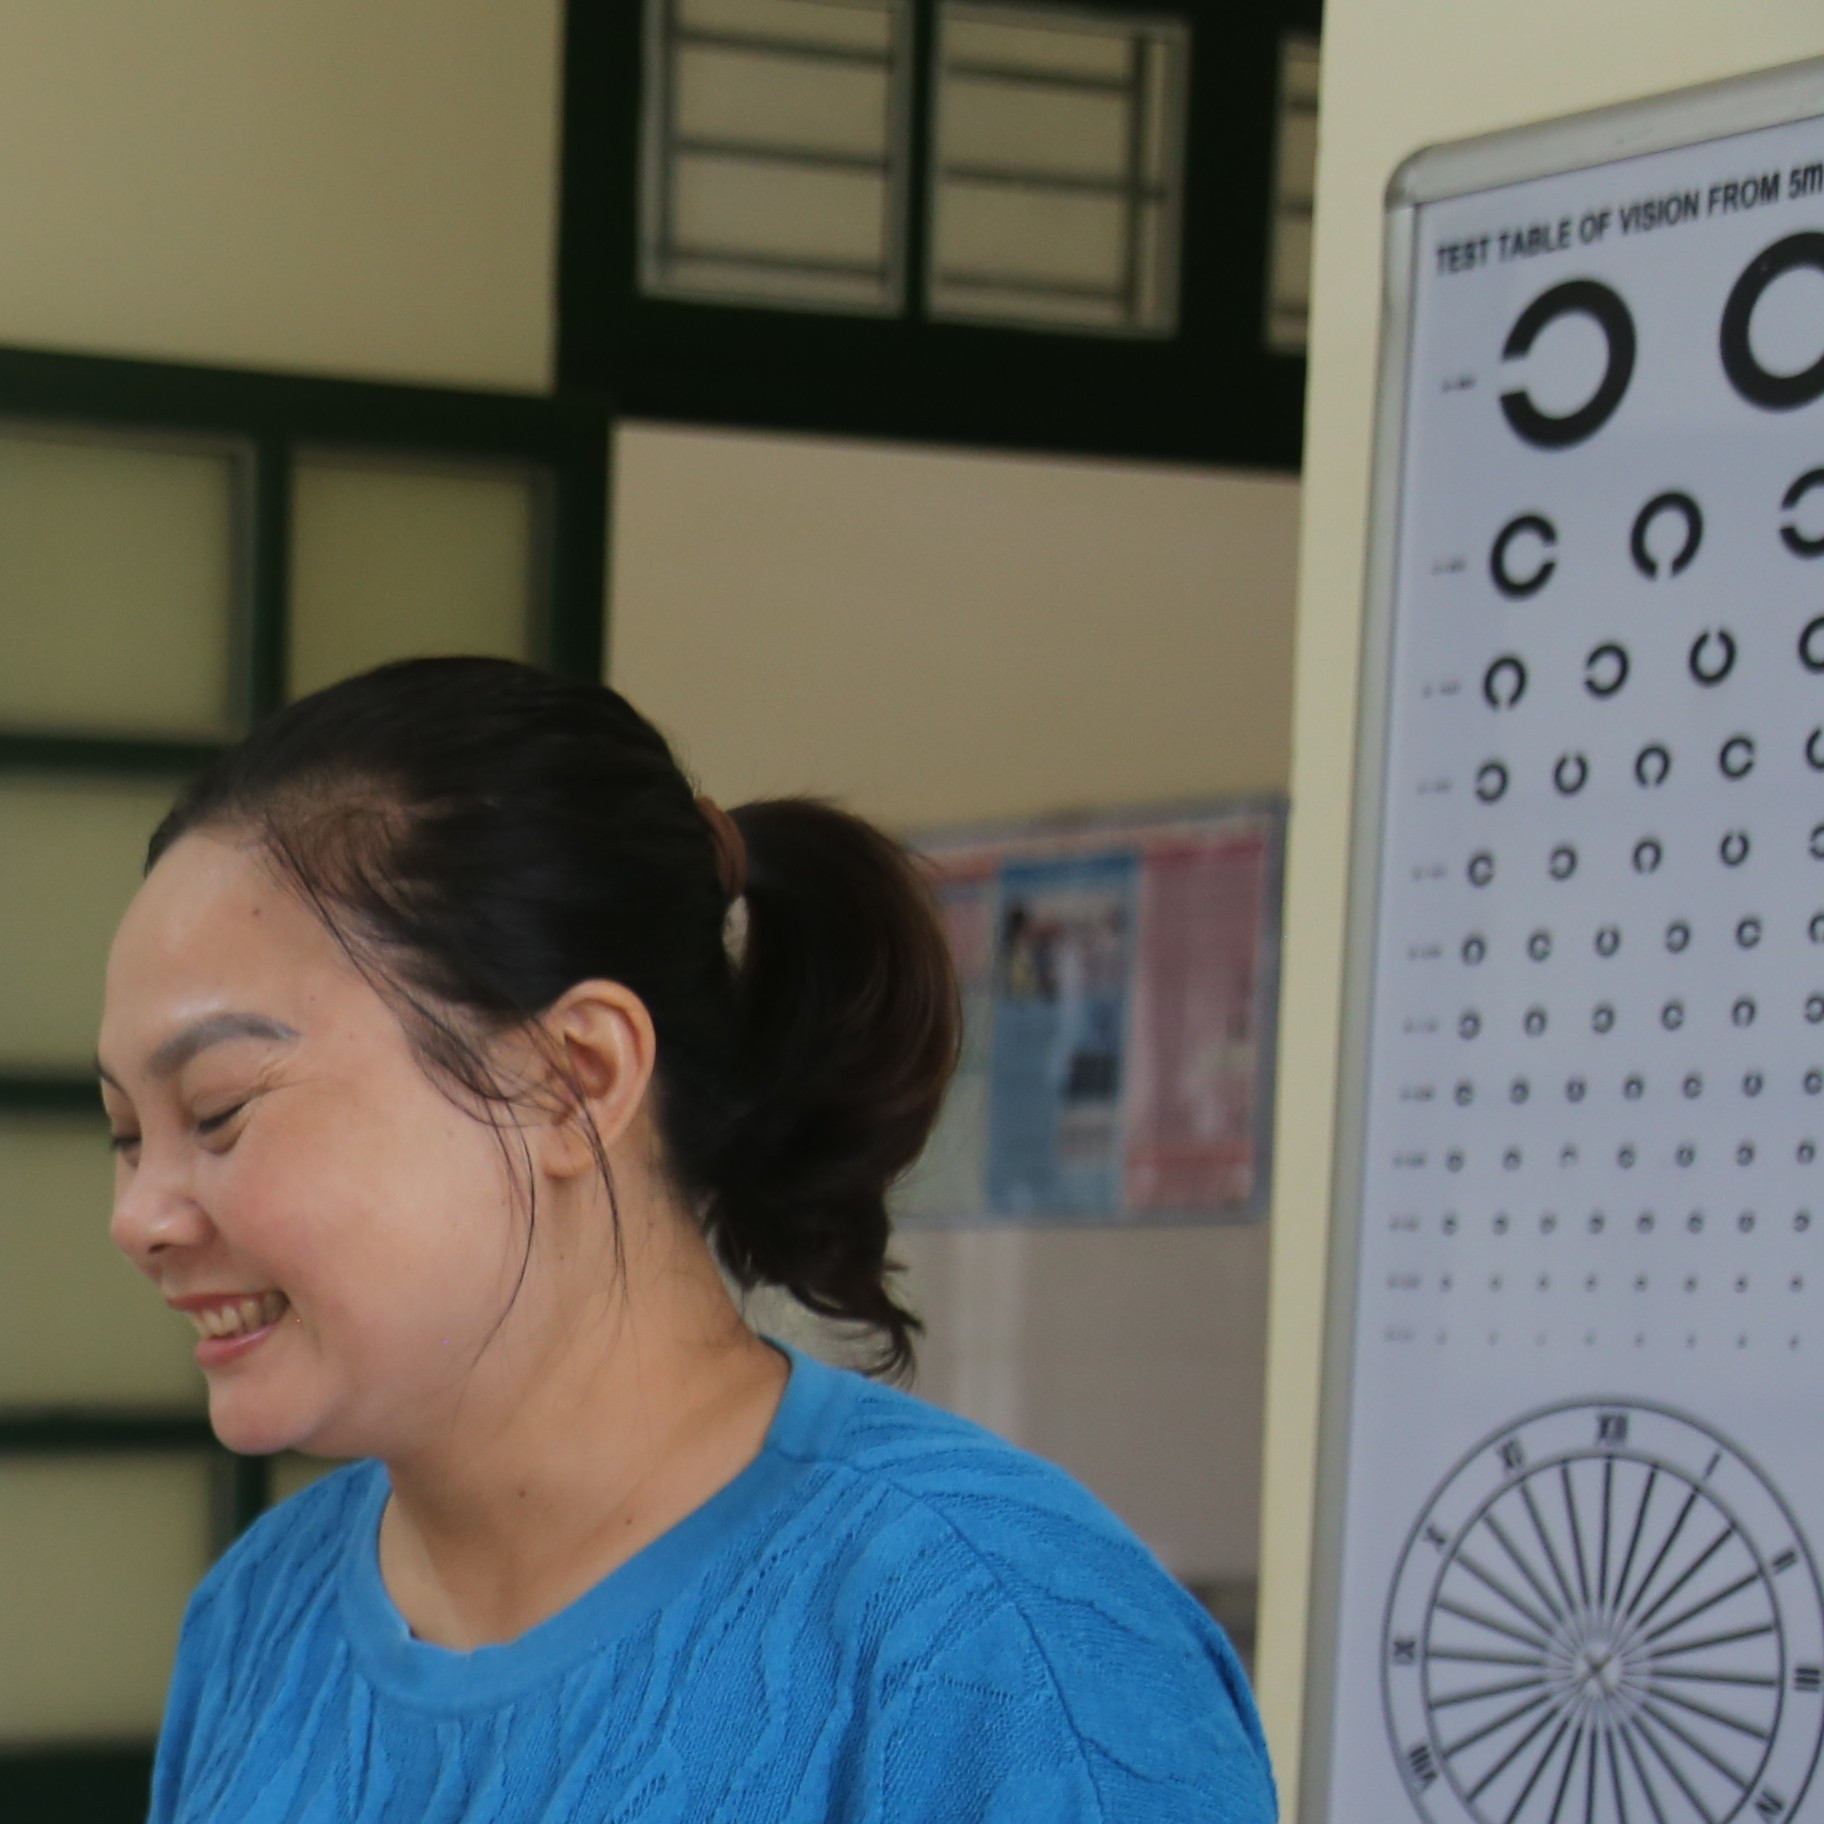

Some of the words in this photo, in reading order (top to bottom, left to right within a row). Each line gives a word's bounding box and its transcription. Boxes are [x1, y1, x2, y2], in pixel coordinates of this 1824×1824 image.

[1436, 234, 1490, 275] TEST
[1498, 215, 1573, 262] TABLE
[1579, 208, 1611, 245] OF
[1618, 189, 1700, 236] VISION
[1706, 171, 1782, 216] FROM
